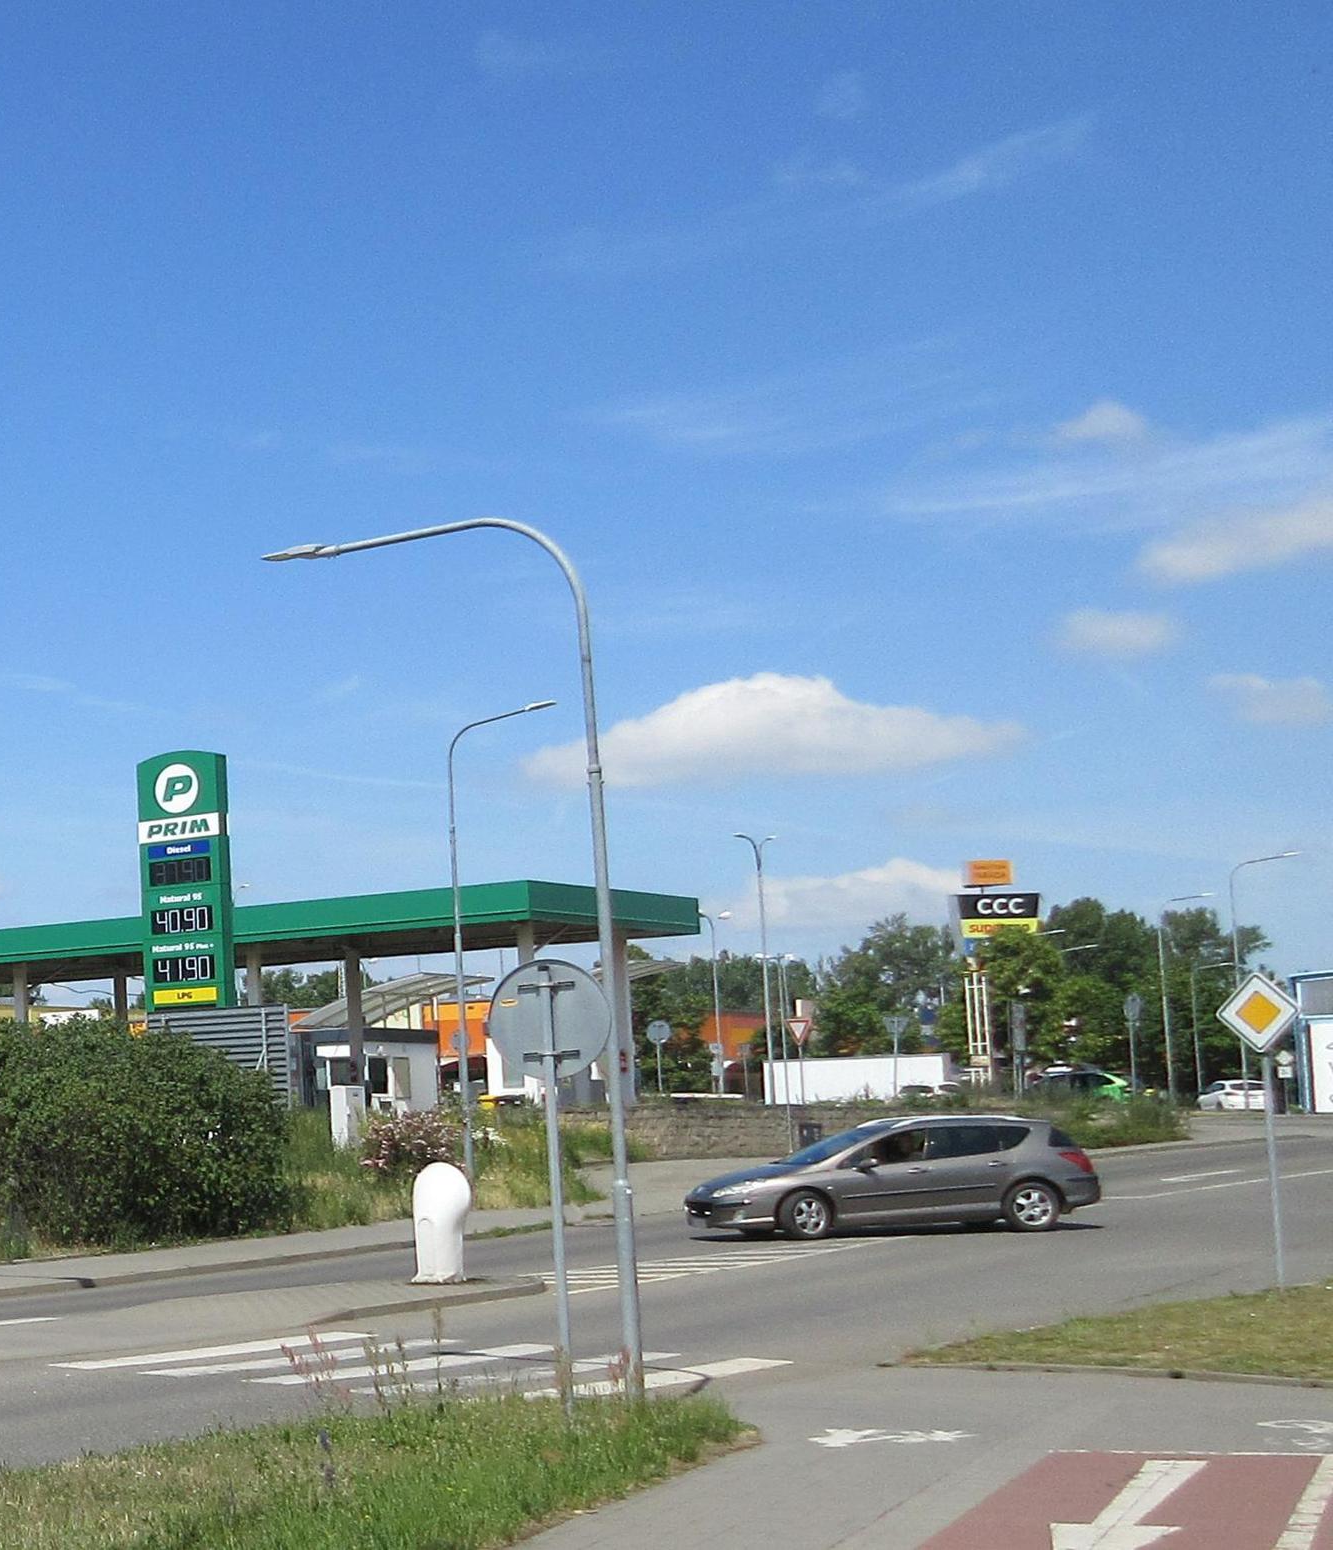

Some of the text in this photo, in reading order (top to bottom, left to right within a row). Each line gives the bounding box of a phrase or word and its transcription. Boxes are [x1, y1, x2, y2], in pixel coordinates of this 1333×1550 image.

[163, 774, 193, 803] P
[147, 818, 210, 839] PRIM
[166, 845, 191, 855] Diesel
[159, 892, 203, 904] Natural 95
[976, 898, 1025, 915] CCC
[156, 907, 209, 933] 40.90
[152, 944, 183, 953] Natural
[184, 942, 195, 950] 95
[158, 956, 210, 981] 41.90
